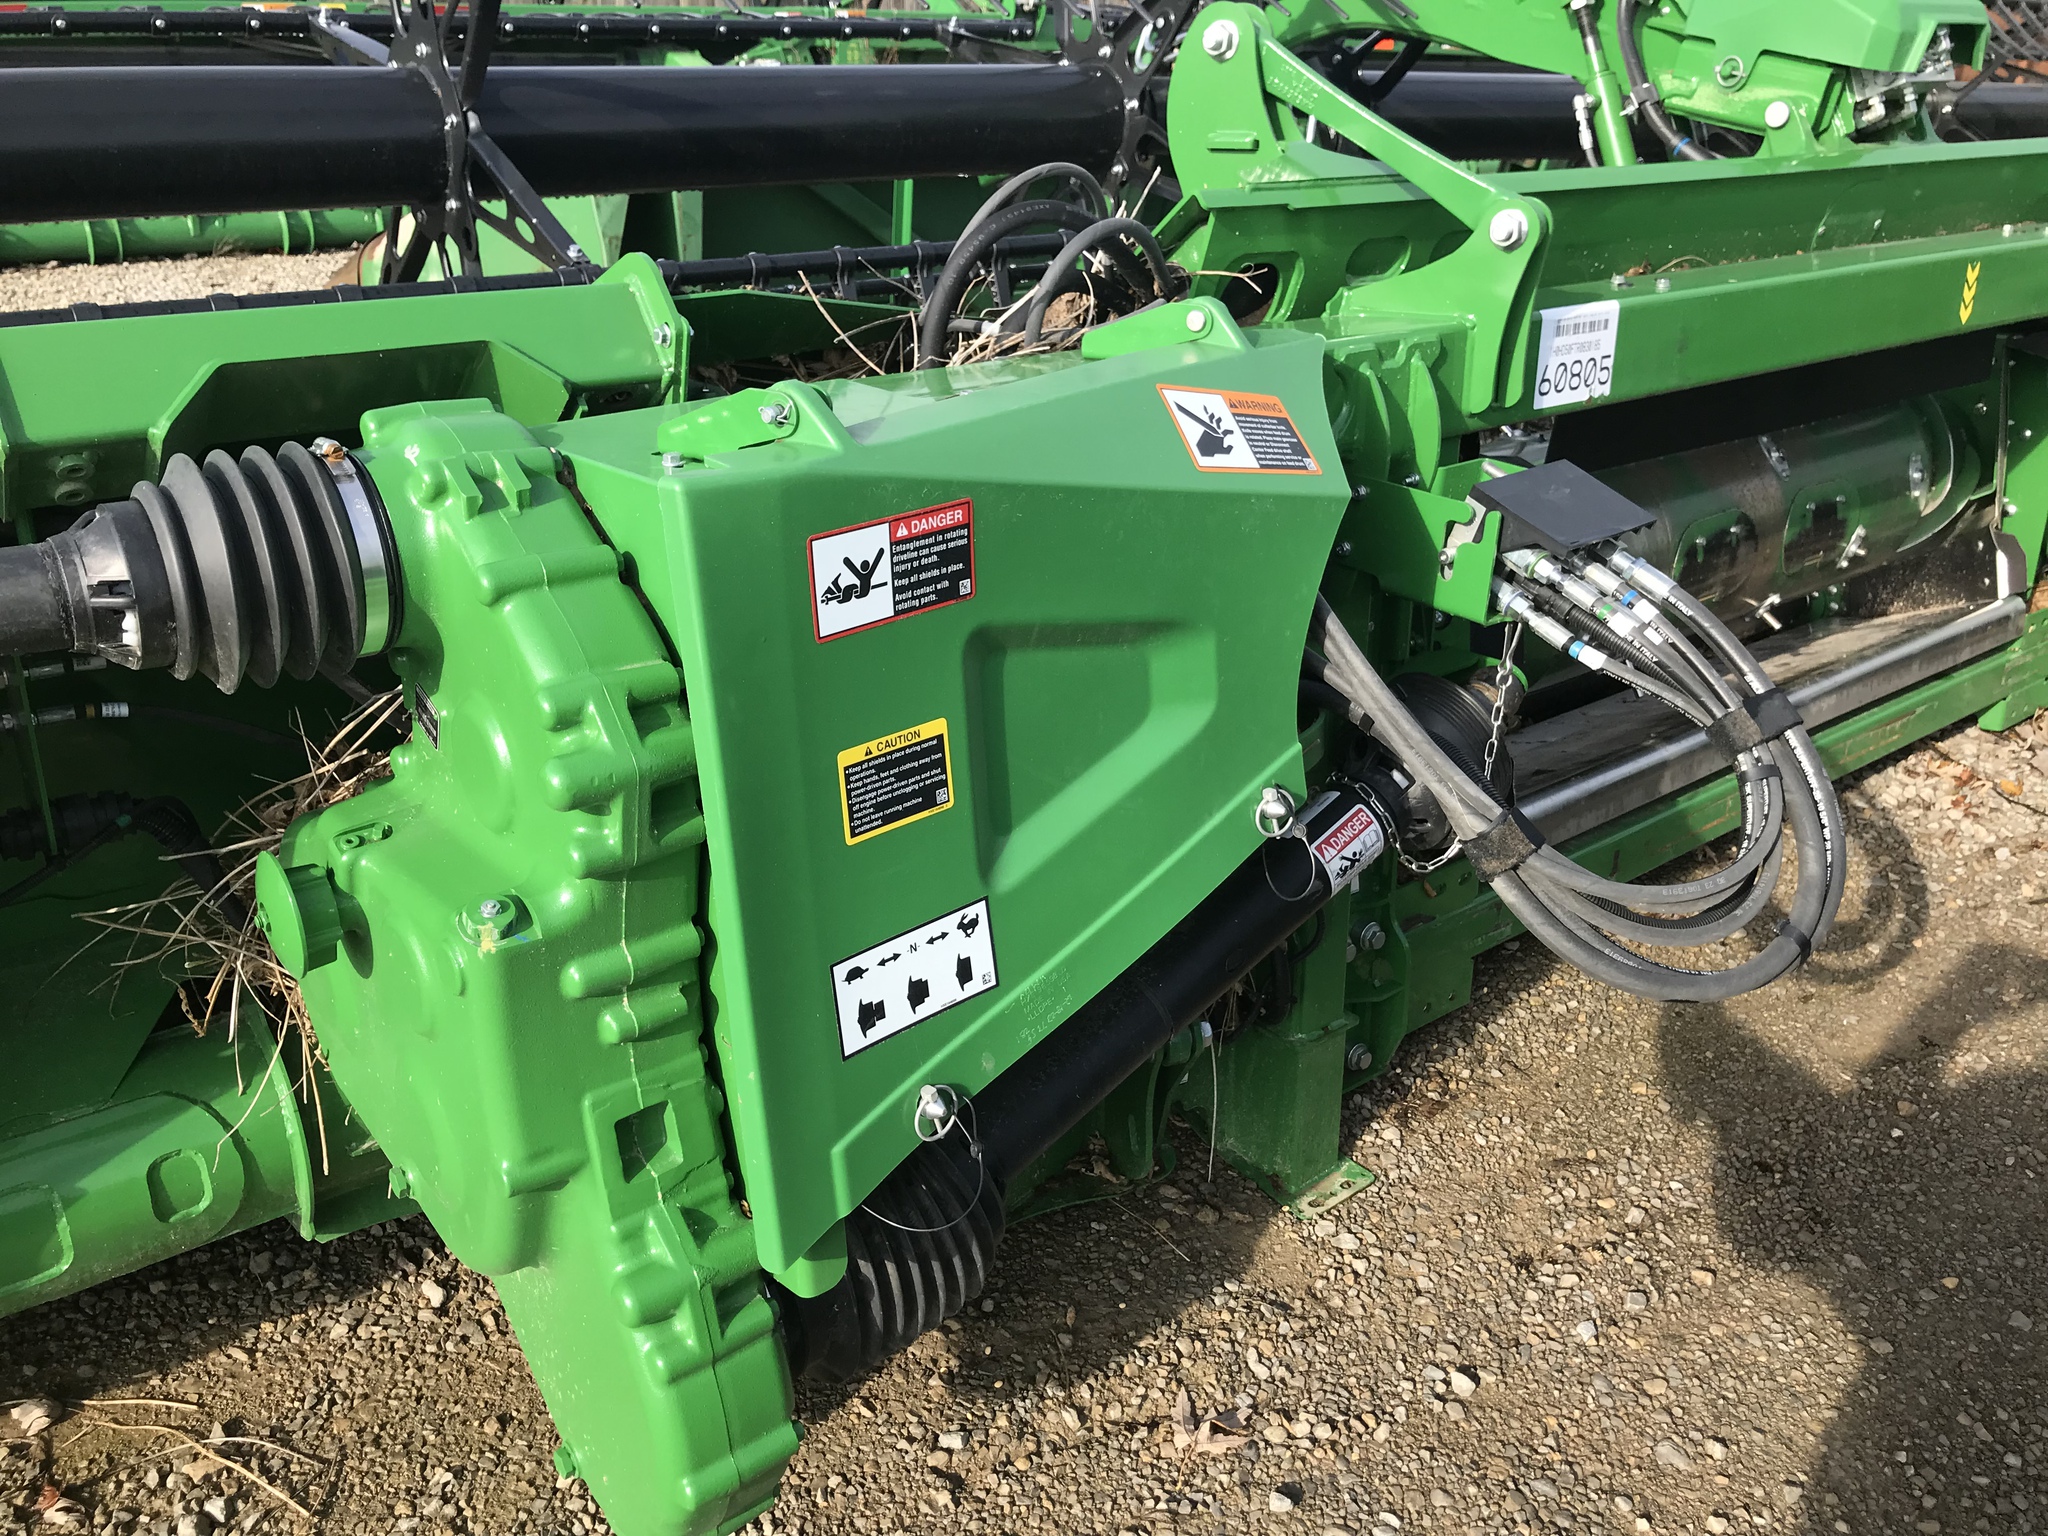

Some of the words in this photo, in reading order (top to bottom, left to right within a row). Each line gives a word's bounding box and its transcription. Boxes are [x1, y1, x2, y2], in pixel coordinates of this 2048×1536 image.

[1538, 354, 1612, 396] 60805
[1236, 400, 1282, 414] WARNING
[911, 510, 963, 534] DANGER
[892, 535, 935, 555] Entanglement
[937, 534, 942, 542] in
[945, 528, 967, 541] rotating
[893, 550, 918, 563] driveline
[919, 548, 929, 556] can
[930, 544, 946, 553] cause
[948, 537, 968, 548] serious
[894, 562, 911, 574] injury
[921, 554, 940, 565] death.
[894, 577, 909, 588] Keep
[910, 574, 918, 583] all
[919, 569, 940, 580] shields
[948, 561, 965, 574] place.
[895, 591, 912, 601] Avoid
[913, 585, 935, 596] contact
[936, 580, 949, 589] with
[896, 598, 919, 612] rotating
[921, 593, 938, 605] parts.
[1640, 644, 1659, 662] ITALY
[876, 729, 921, 752] CAUTION
[849, 764, 861, 774] Keep
[869, 756, 886, 766] shields
[892, 750, 904, 760] place
[905, 745, 920, 755] during
[921, 739, 937, 748] normal
[850, 780, 863, 789] Keep
[890, 767, 899, 775] and
[899, 760, 918, 772] clothing
[919, 757, 930, 765] away
[931, 752, 942, 760] from
[851, 781, 882, 797] power-driven
[852, 790, 877, 805] Disengage
[878, 779, 908, 795] power-driven
[908, 775, 920, 784] parts
[860, 799, 876, 810] engine
[877, 793, 892, 802] before
[893, 783, 918, 798] unclogging
[925, 773, 946, 786] servicing
[871, 811, 883, 820] leave
[884, 804, 902, 816] running
[903, 796, 922, 808] machine
[1329, 811, 1371, 851] DANGER
